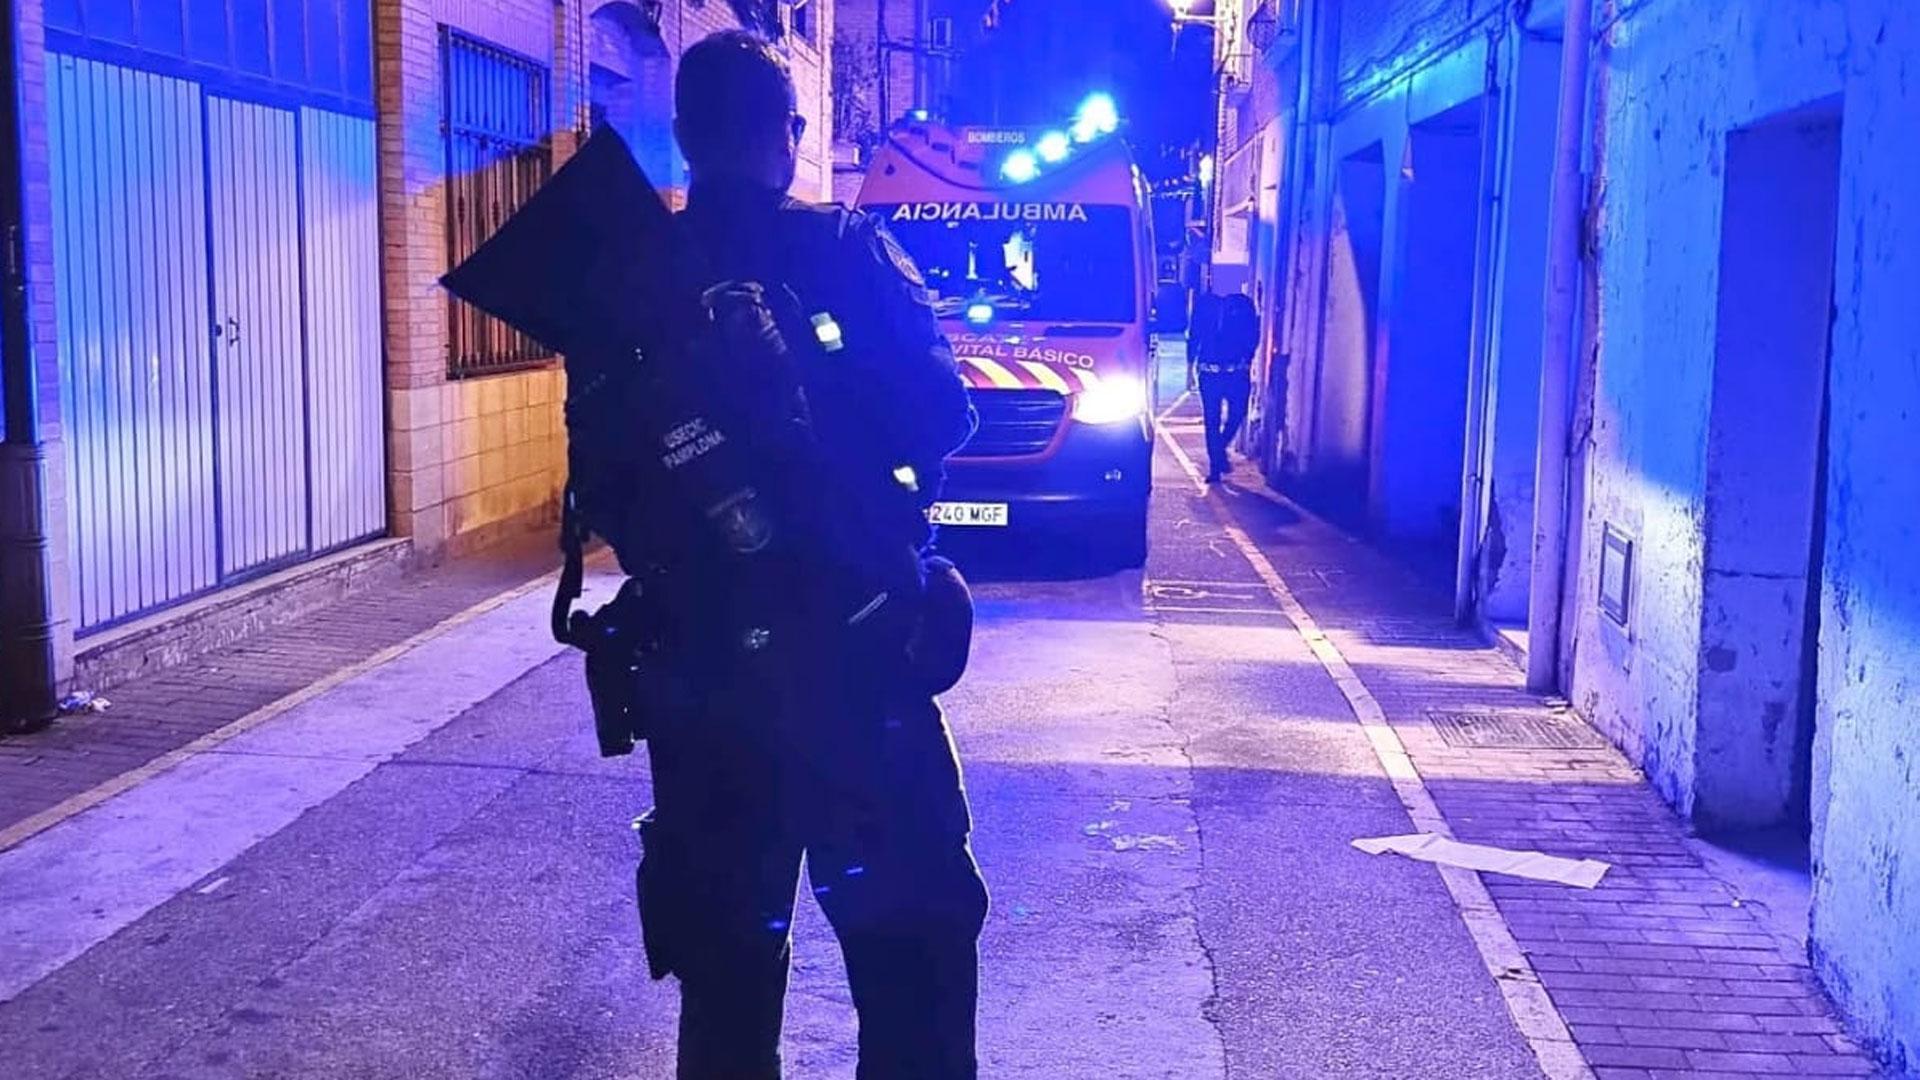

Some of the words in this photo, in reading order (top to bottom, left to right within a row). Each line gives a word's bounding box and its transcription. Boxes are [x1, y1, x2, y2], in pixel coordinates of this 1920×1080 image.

[967, 131, 1026, 143] BOMBEROS
[953, 344, 1008, 357] VITAL
[1013, 346, 1095, 368] BÁSICO
[662, 430, 726, 469] PAMPLONA
[970, 506, 1004, 522] MGF
